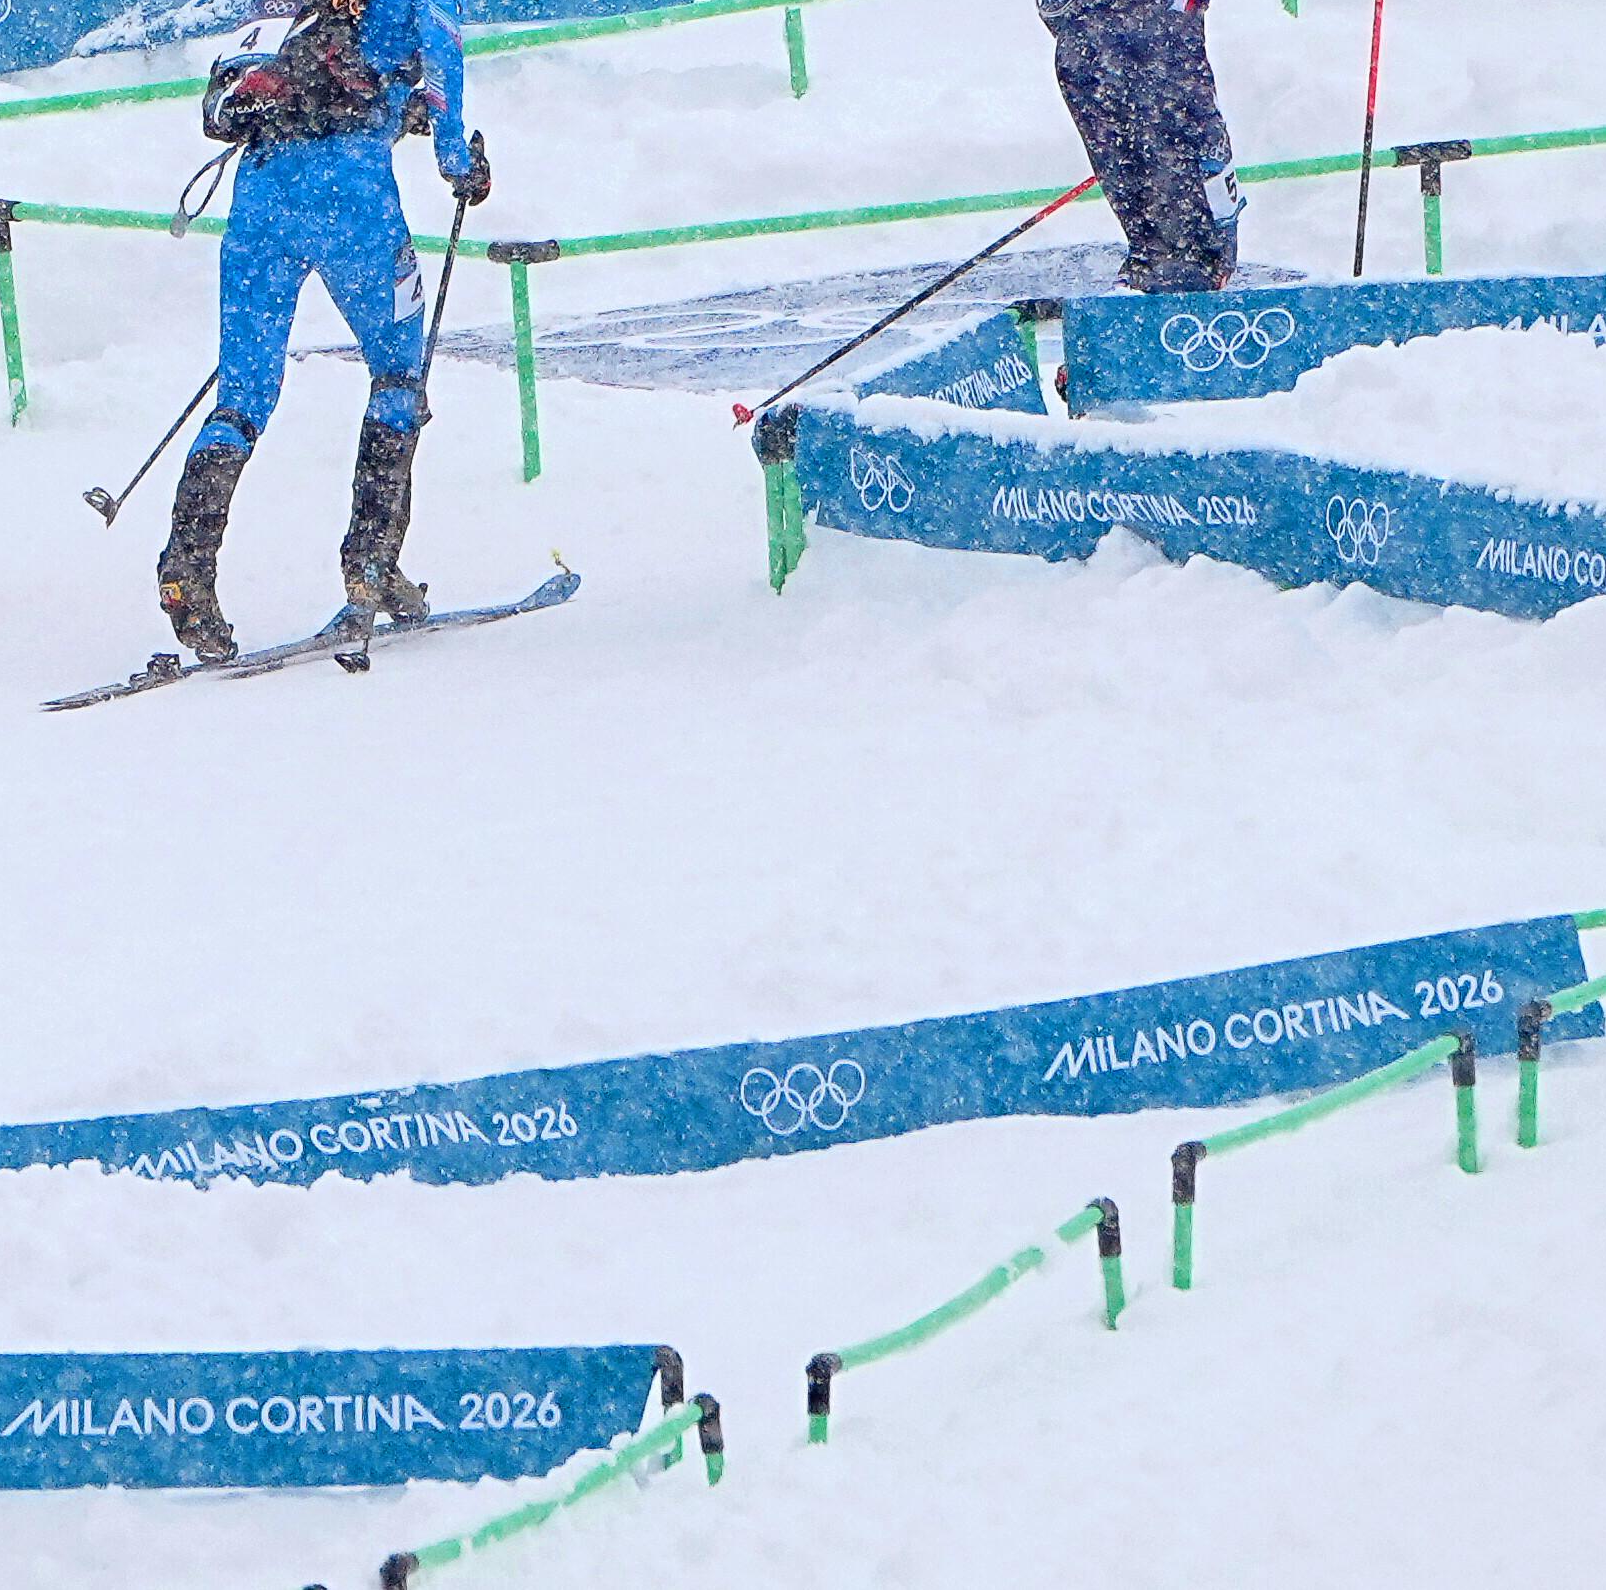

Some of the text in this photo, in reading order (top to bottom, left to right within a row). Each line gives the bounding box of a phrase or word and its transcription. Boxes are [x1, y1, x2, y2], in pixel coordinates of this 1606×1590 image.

[240, 26, 261, 50] 4
[1224, 171, 1237, 203] 5
[994, 353, 1033, 393] 2026
[993, 486, 1257, 526] MILANO CORTINA 2026
[1476, 537, 1570, 582] MILANO
[1043, 969, 1504, 1082] MILANO CORTINA 2026
[132, 1102, 579, 1179] MILANO CORTINA 2026
[0, 1390, 562, 1438] MILANO CORTINA 2026
